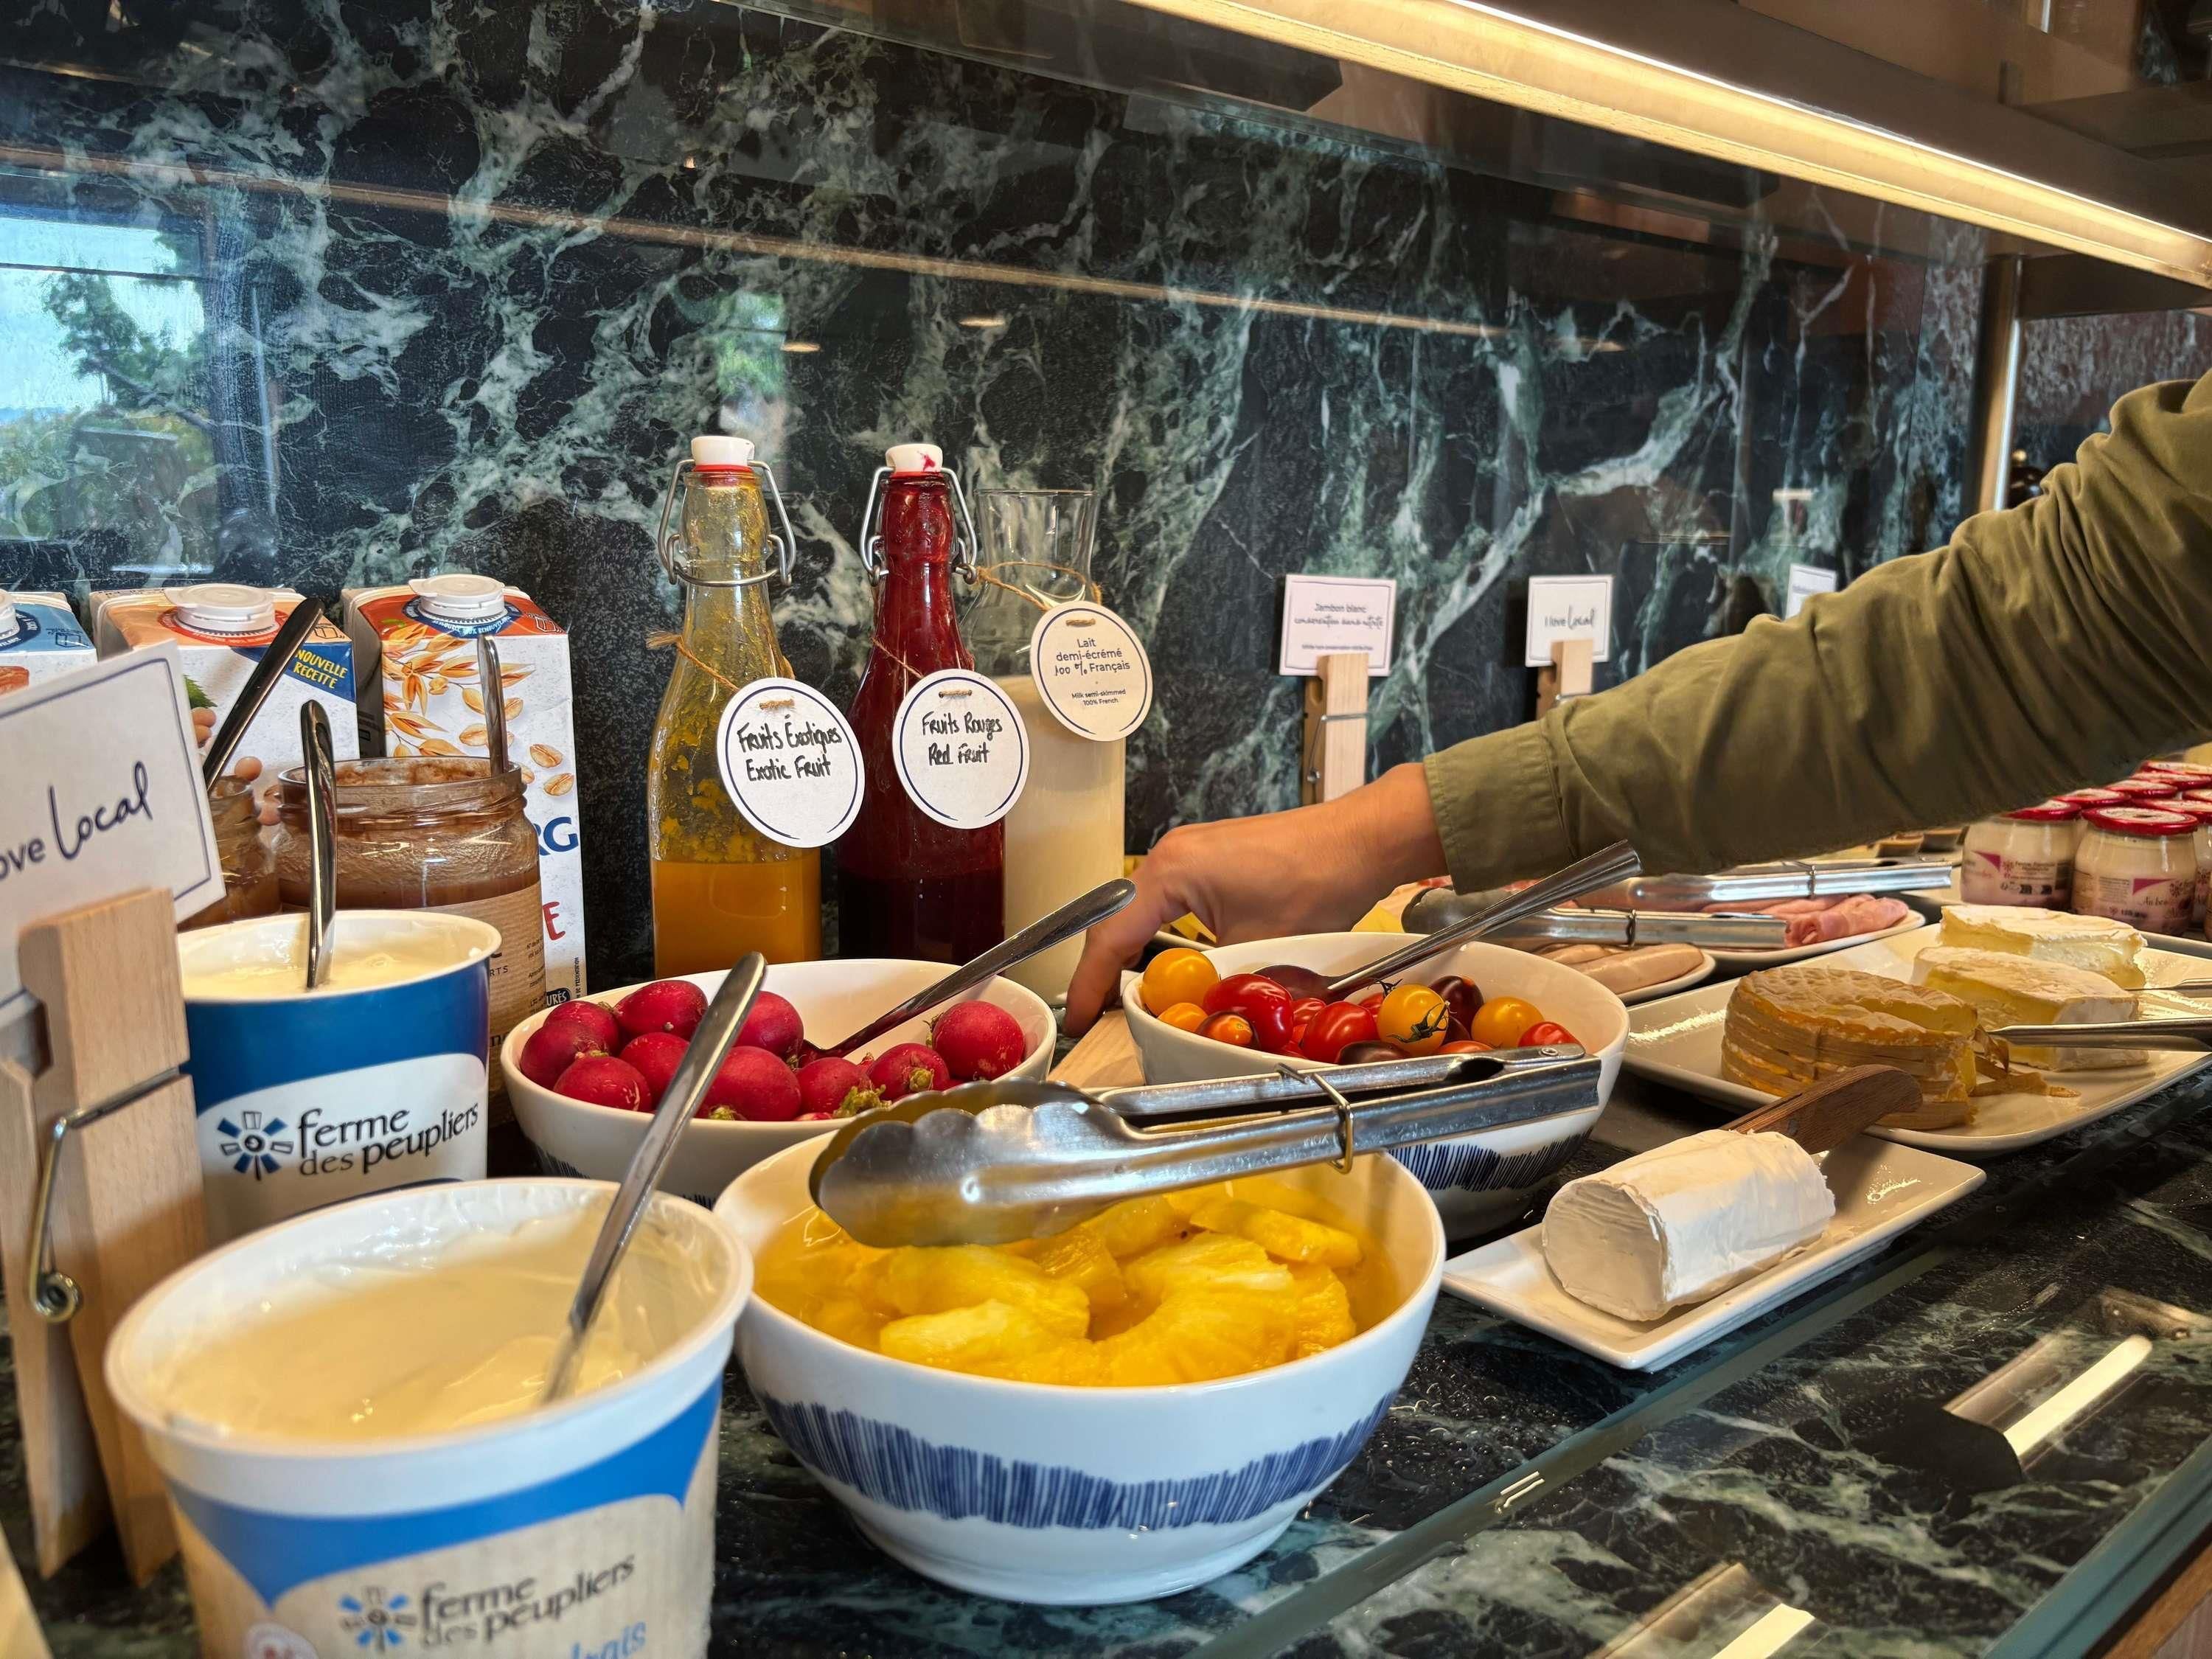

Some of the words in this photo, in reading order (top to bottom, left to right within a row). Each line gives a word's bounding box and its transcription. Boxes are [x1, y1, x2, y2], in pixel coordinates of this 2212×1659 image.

[1314, 603, 1344, 612] Jambon
[1346, 604, 1367, 613] blanc
[1549, 616, 1566, 627] love
[1056, 648, 1122, 661] demi-écrémé
[1077, 637, 1096, 648] Lait
[293, 661, 338, 689] RECETTE
[295, 649, 348, 679] NOUVELLE
[1054, 665, 1071, 676] 100
[1074, 661, 1088, 676] %
[1089, 661, 1130, 673] Français
[1085, 689, 1126, 698] semi-skimmed
[737, 722, 784, 753] Fruits
[922, 711, 960, 736] Fruits
[964, 712, 1003, 741] Rouges
[745, 758, 792, 782] Exotic
[794, 754, 831, 779] Fruit
[928, 742, 953, 766] Red
[48, 760, 153, 860] Local
[298, 1107, 410, 1158] ferme
[299, 1150, 354, 1177] des
[361, 1102, 479, 1174] peupliers
[421, 1581, 537, 1631] ferme
[484, 1554, 635, 1644] peupliers
